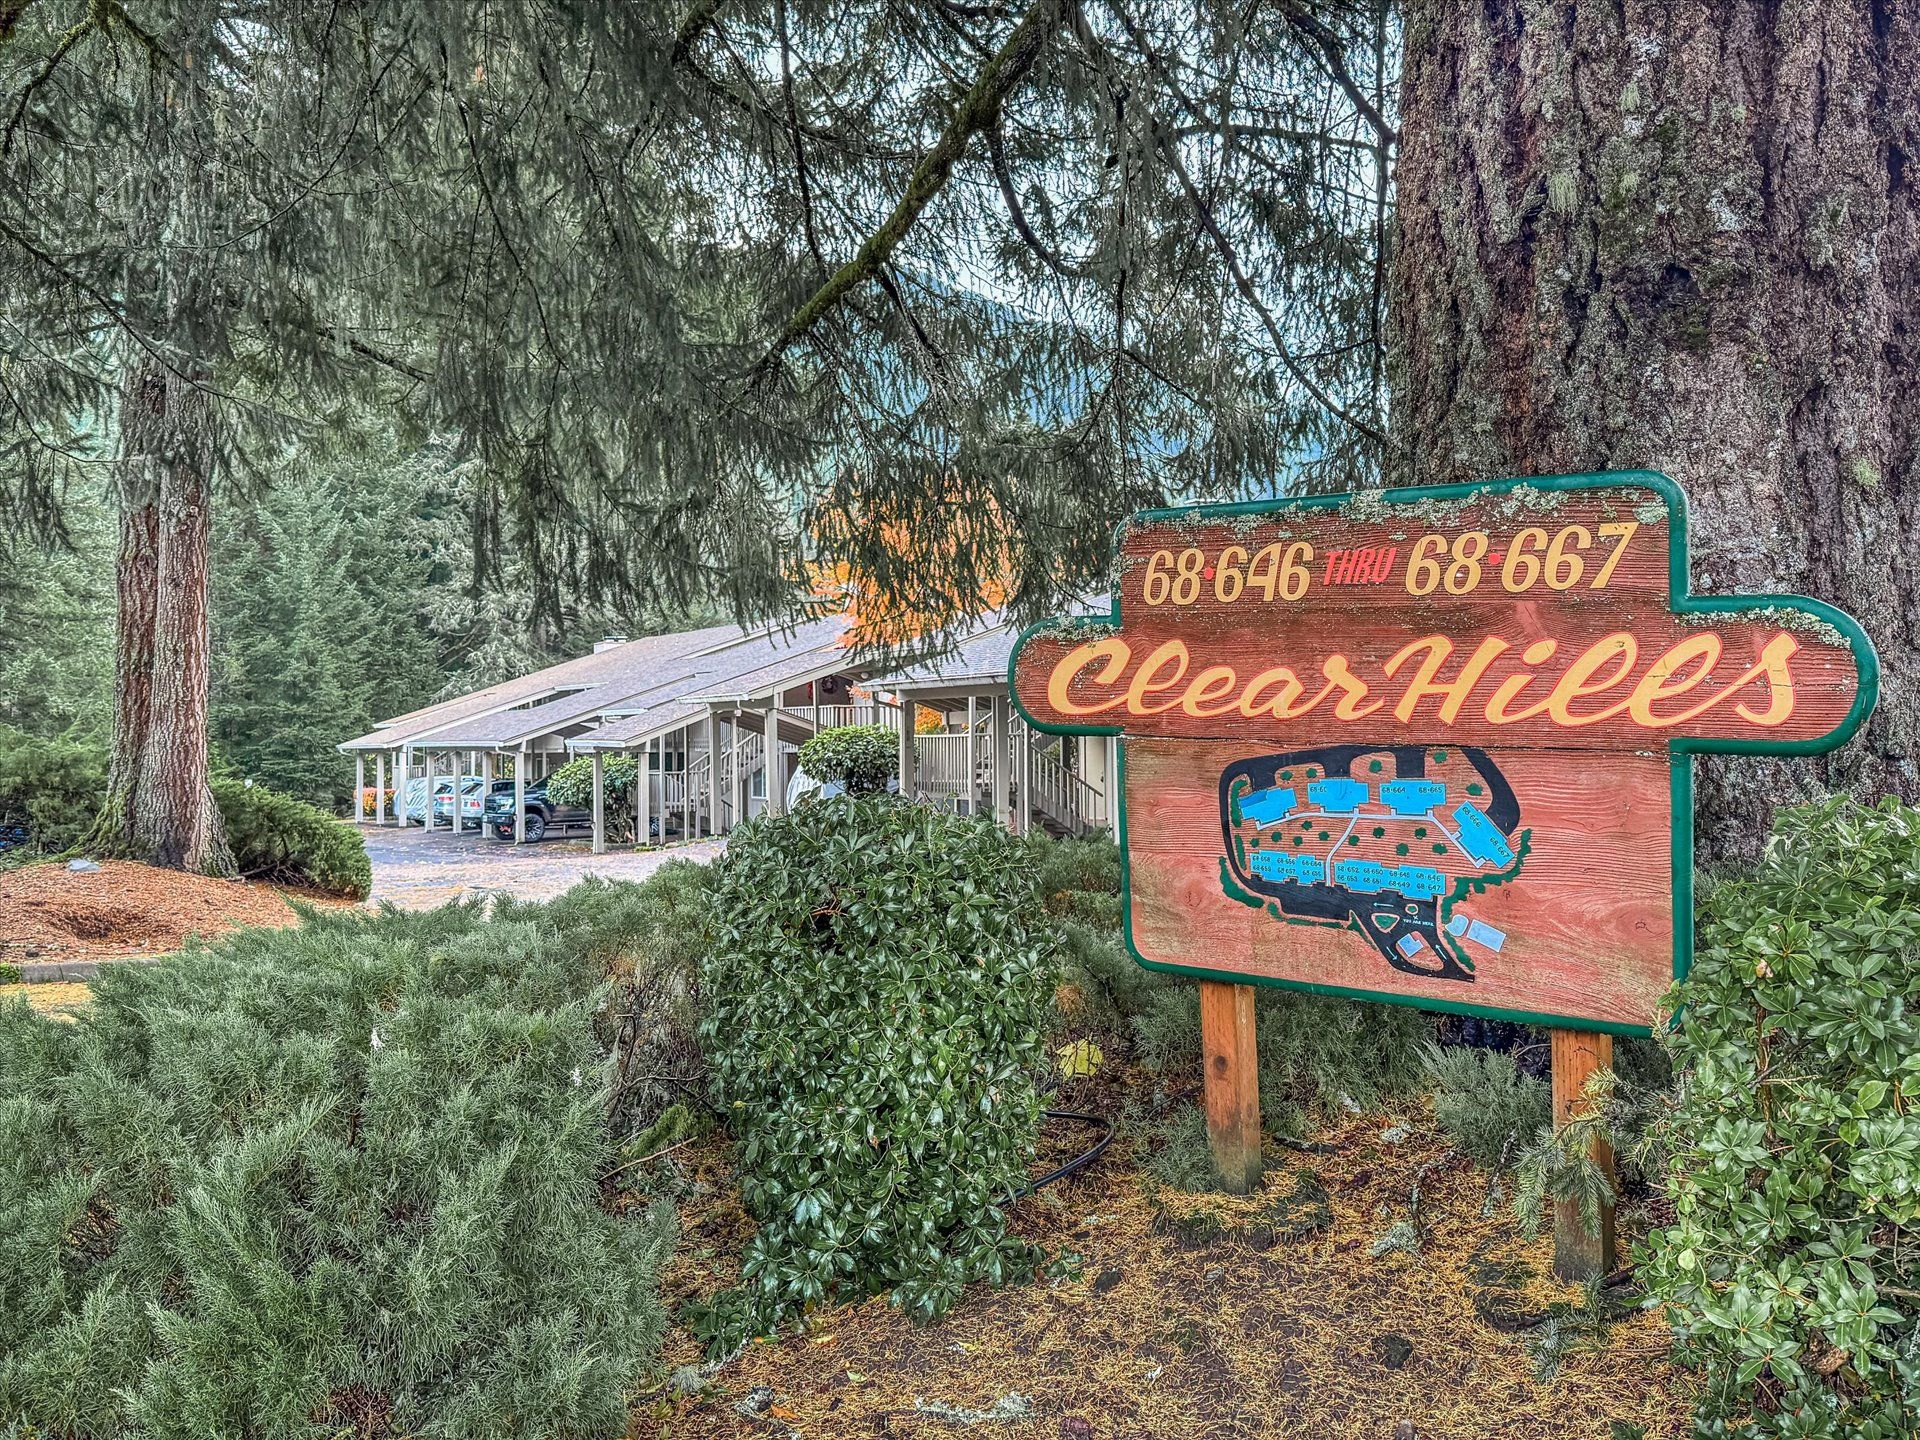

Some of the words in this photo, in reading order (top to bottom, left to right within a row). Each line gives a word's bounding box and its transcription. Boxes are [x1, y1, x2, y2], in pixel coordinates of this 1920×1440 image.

[1322, 547, 1398, 586] THRU
[1047, 637, 1386, 721] Clear
[1382, 631, 1800, 729] Hills
